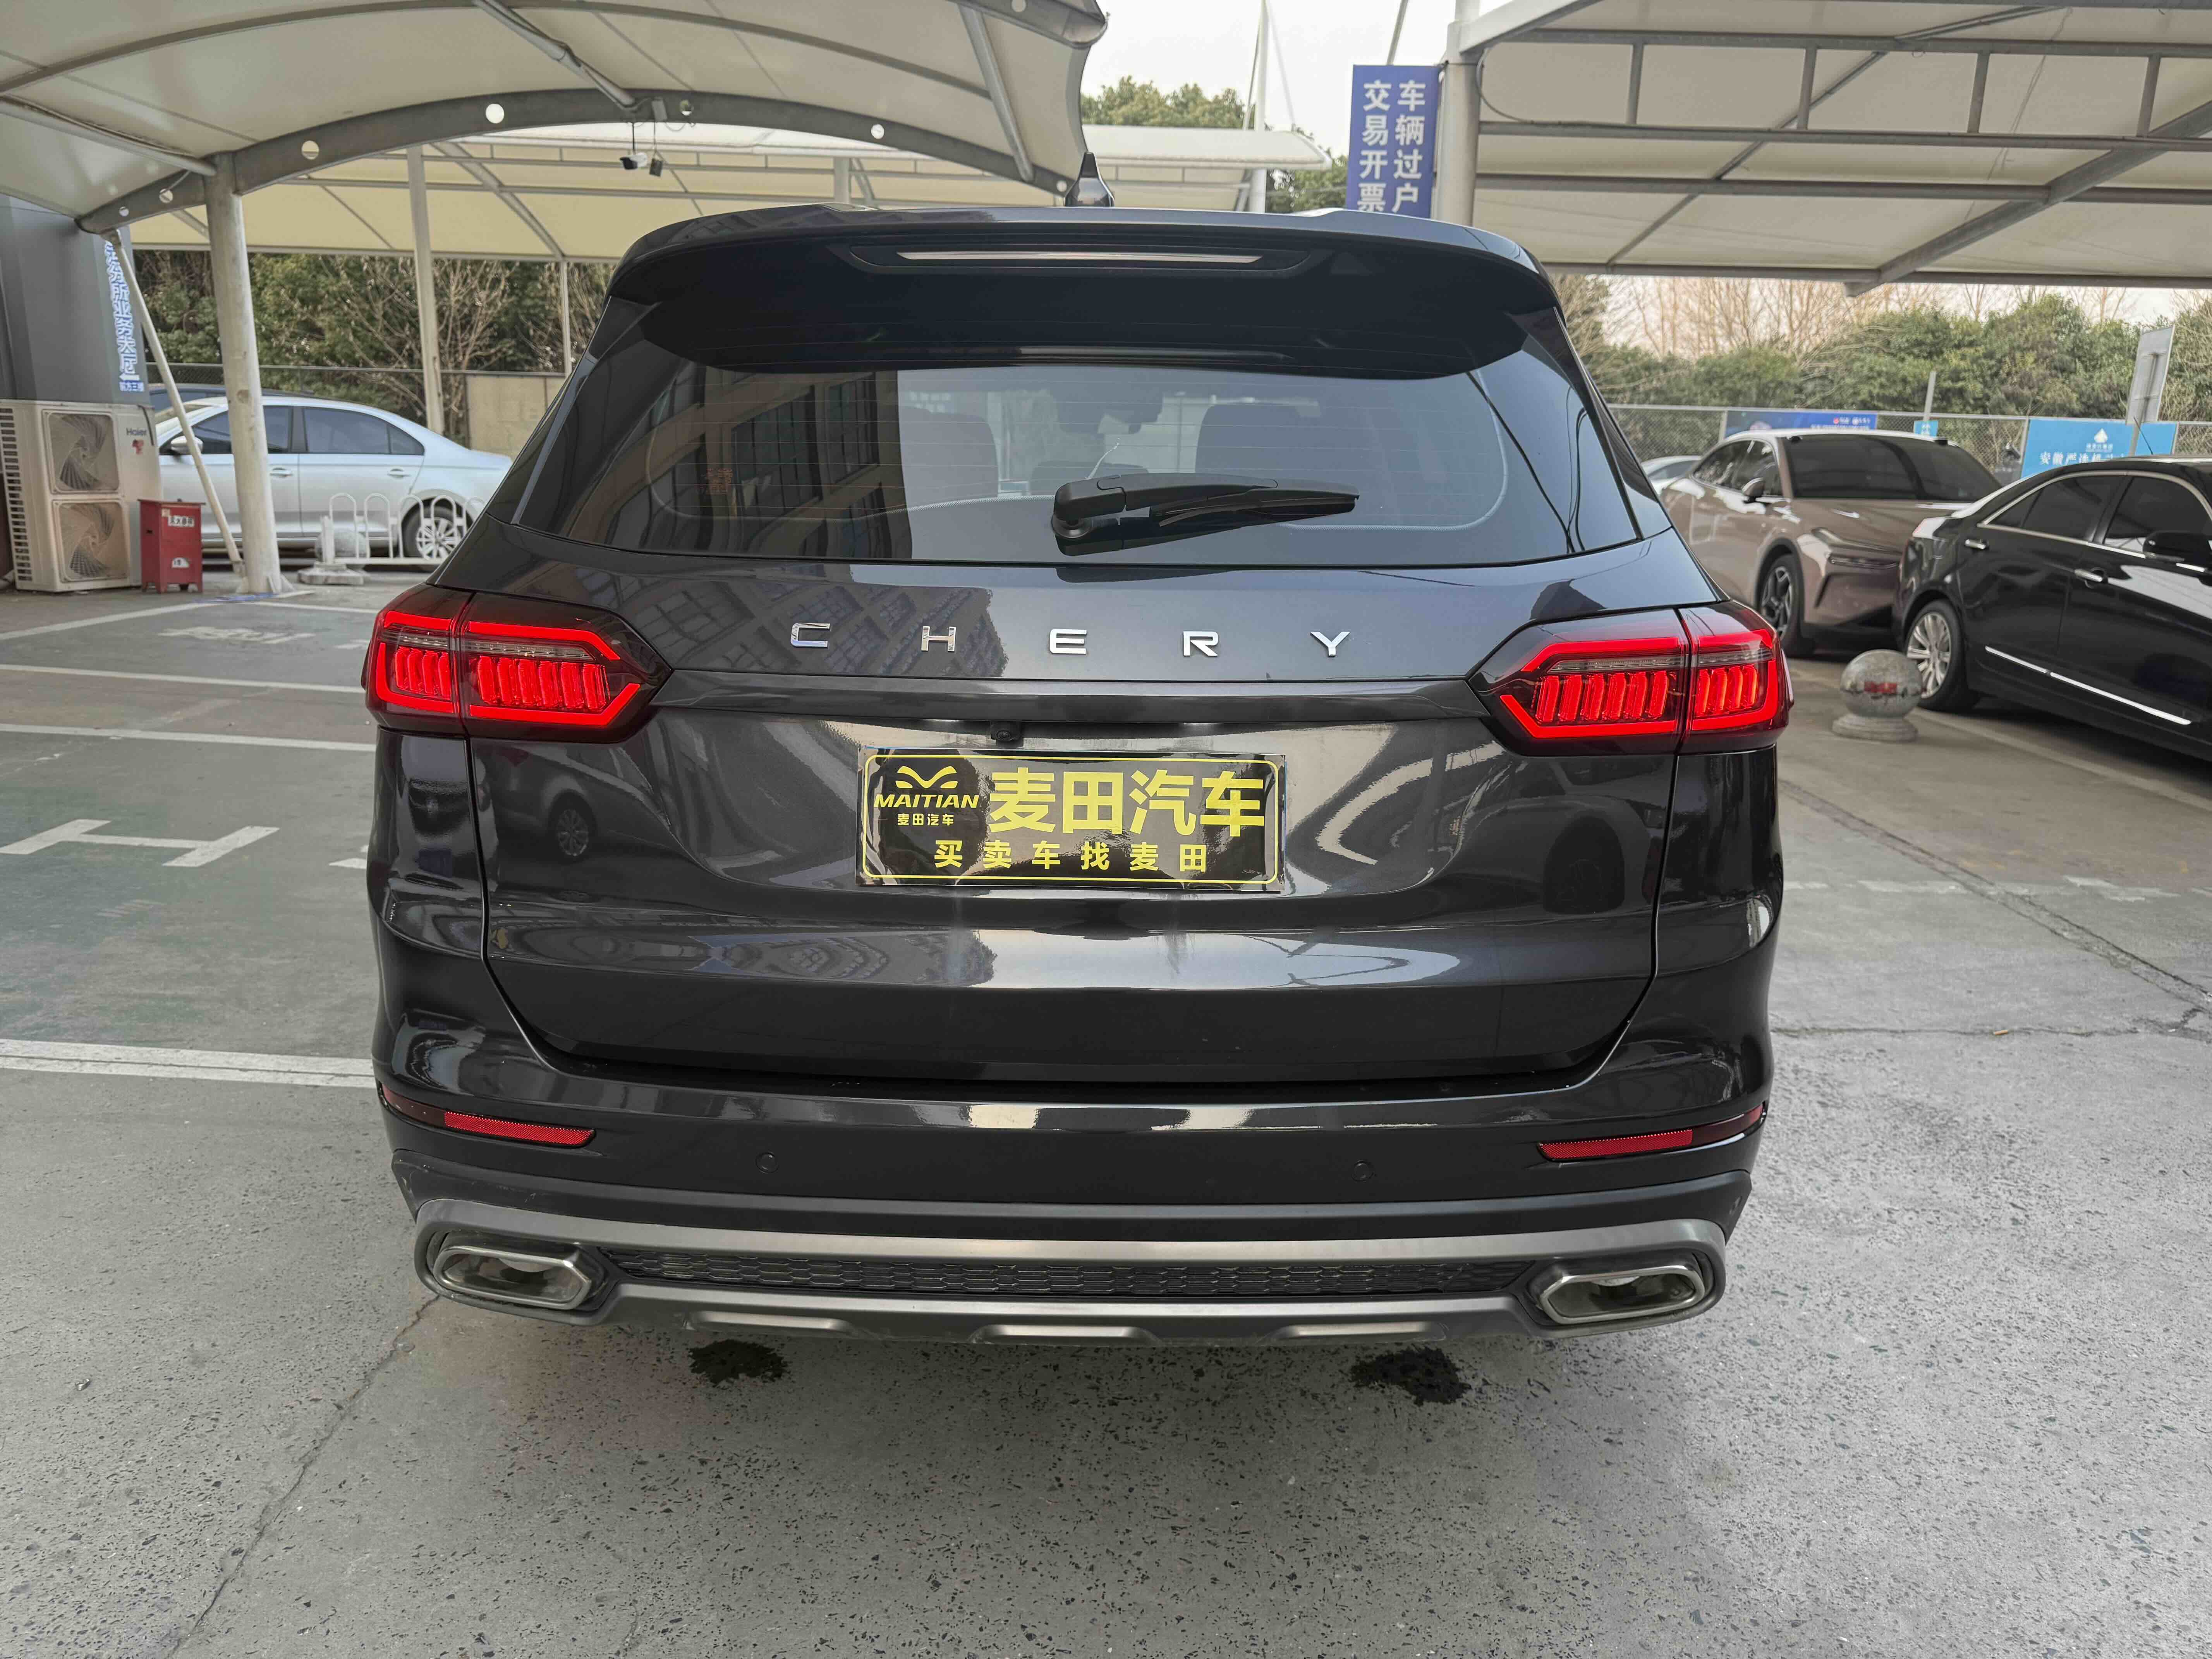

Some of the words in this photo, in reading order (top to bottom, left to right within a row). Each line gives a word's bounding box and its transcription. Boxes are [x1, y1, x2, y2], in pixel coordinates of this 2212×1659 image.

[1357, 80, 1391, 211] 交易开票
[1393, 80, 1425, 213] 车辆过户
[126, 428, 147, 436] Haier
[790, 622, 1351, 657] CHERY
[874, 794, 979, 808] MAITIAN
[989, 767, 1265, 838] 麦田汽车
[897, 813, 955, 826] 麦田汽车
[934, 840, 1207, 872] 买卖车找麦田
